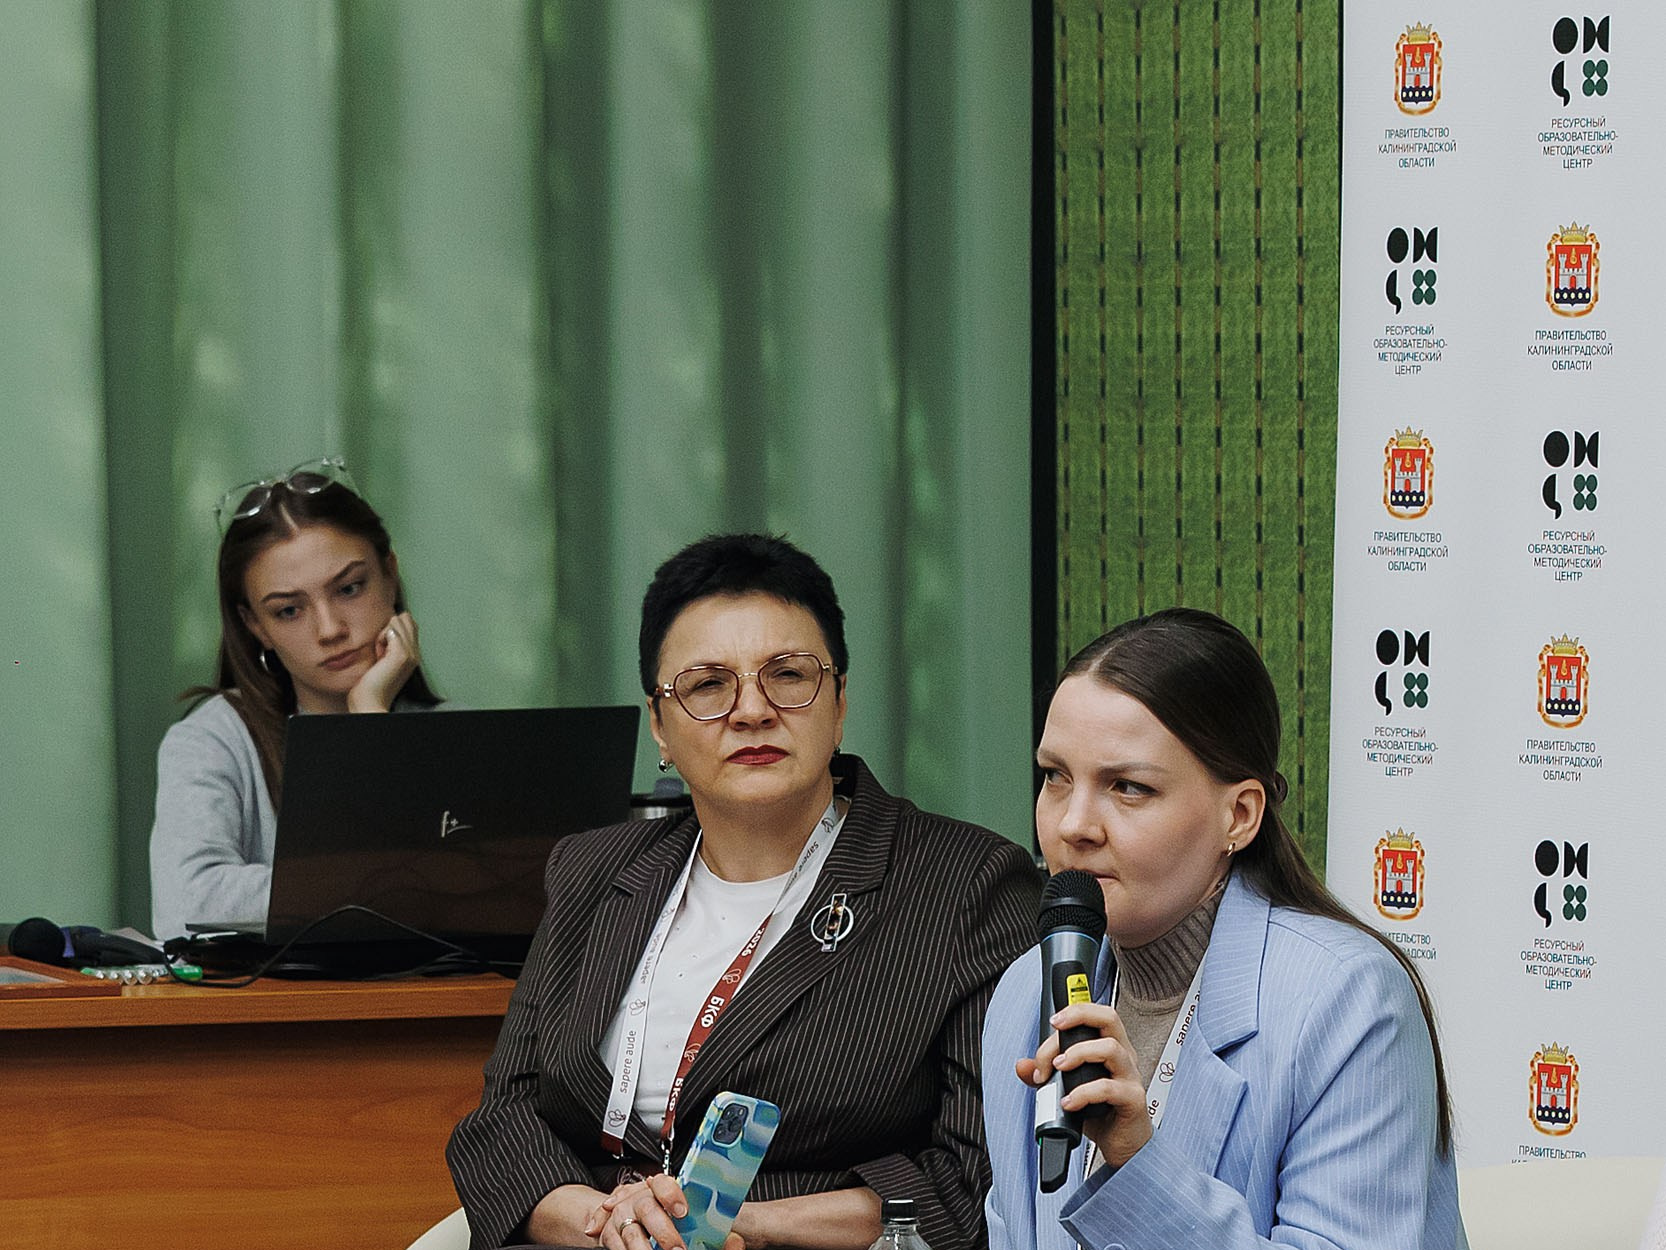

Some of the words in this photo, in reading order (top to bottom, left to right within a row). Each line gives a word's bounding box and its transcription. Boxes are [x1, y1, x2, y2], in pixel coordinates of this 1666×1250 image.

[1551, 116, 1606, 128] РЕСУРСНЫЙ
[1385, 127, 1450, 139] ПРАВИТЕЛЬСТВО
[1537, 131, 1619, 143] ОБРАЗОВАТЕЛЬНО-
[1378, 141, 1457, 154] КАЛИНИНГРАДСКОЙ
[1542, 143, 1613, 156] МЕТОДИЧЕСКИЙ
[1398, 157, 1435, 168] ОБЛАСТИ
[1562, 158, 1593, 171] ЦЕНТР
[1385, 324, 1435, 336] РЕСУРСНЫЙ
[1535, 329, 1607, 341] ПРАВИТЕЛЬСТВО
[1373, 338, 1448, 349] ОБРАЗОВАТЕЛЬНО-
[1527, 343, 1614, 356] КАЛИНИНГРАДСКОЙ
[1377, 350, 1442, 363] МЕТОДИЧЕСКИЙ
[1394, 364, 1422, 376] ЦЕНТР
[1551, 359, 1592, 371] ОБЛАСТИ
[1373, 531, 1442, 543] ПРАВИТЕЛЬСТВО
[1542, 529, 1596, 541] РЕСУРСНЫЙ
[1367, 545, 1449, 558] КАЛИНИНГРАДСКОЙ
[1527, 543, 1608, 555] ОБРАЗОВАТЕЛЬНО-
[1387, 560, 1427, 572] ОБЛАСТИ
[1533, 556, 1602, 569] МЕТОДИЧЕСКИЙ
[1554, 570, 1583, 583] ЦЕНТР
[1374, 726, 1426, 738] РЕСУРСНЫЙ
[1362, 739, 1439, 752] ОБРАЗОВАТЕЛЬНО-
[1526, 739, 1596, 753] ПРАВИТЕЛЬСТВО
[1366, 752, 1433, 765] МЕТОДИЧЕСКИЙ
[1518, 754, 1603, 768] КАЛИНИНГРАДСКОЙ
[1384, 765, 1414, 778] ЦЕНТР
[1543, 769, 1582, 782] ОБЛАСТИ
[1533, 938, 1585, 952] РЕСУРСНЫЙ
[1520, 951, 1598, 966] ОБРАЗОВАТЕЛЬНО-
[1525, 964, 1592, 979] МЕТОДИЧЕСКИЙ
[1544, 979, 1573, 992] ЦЕНТР
[701, 995, 725, 1028] БКФ
[625, 1030, 637, 1056] aude
[620, 1058, 633, 1095] sapere
